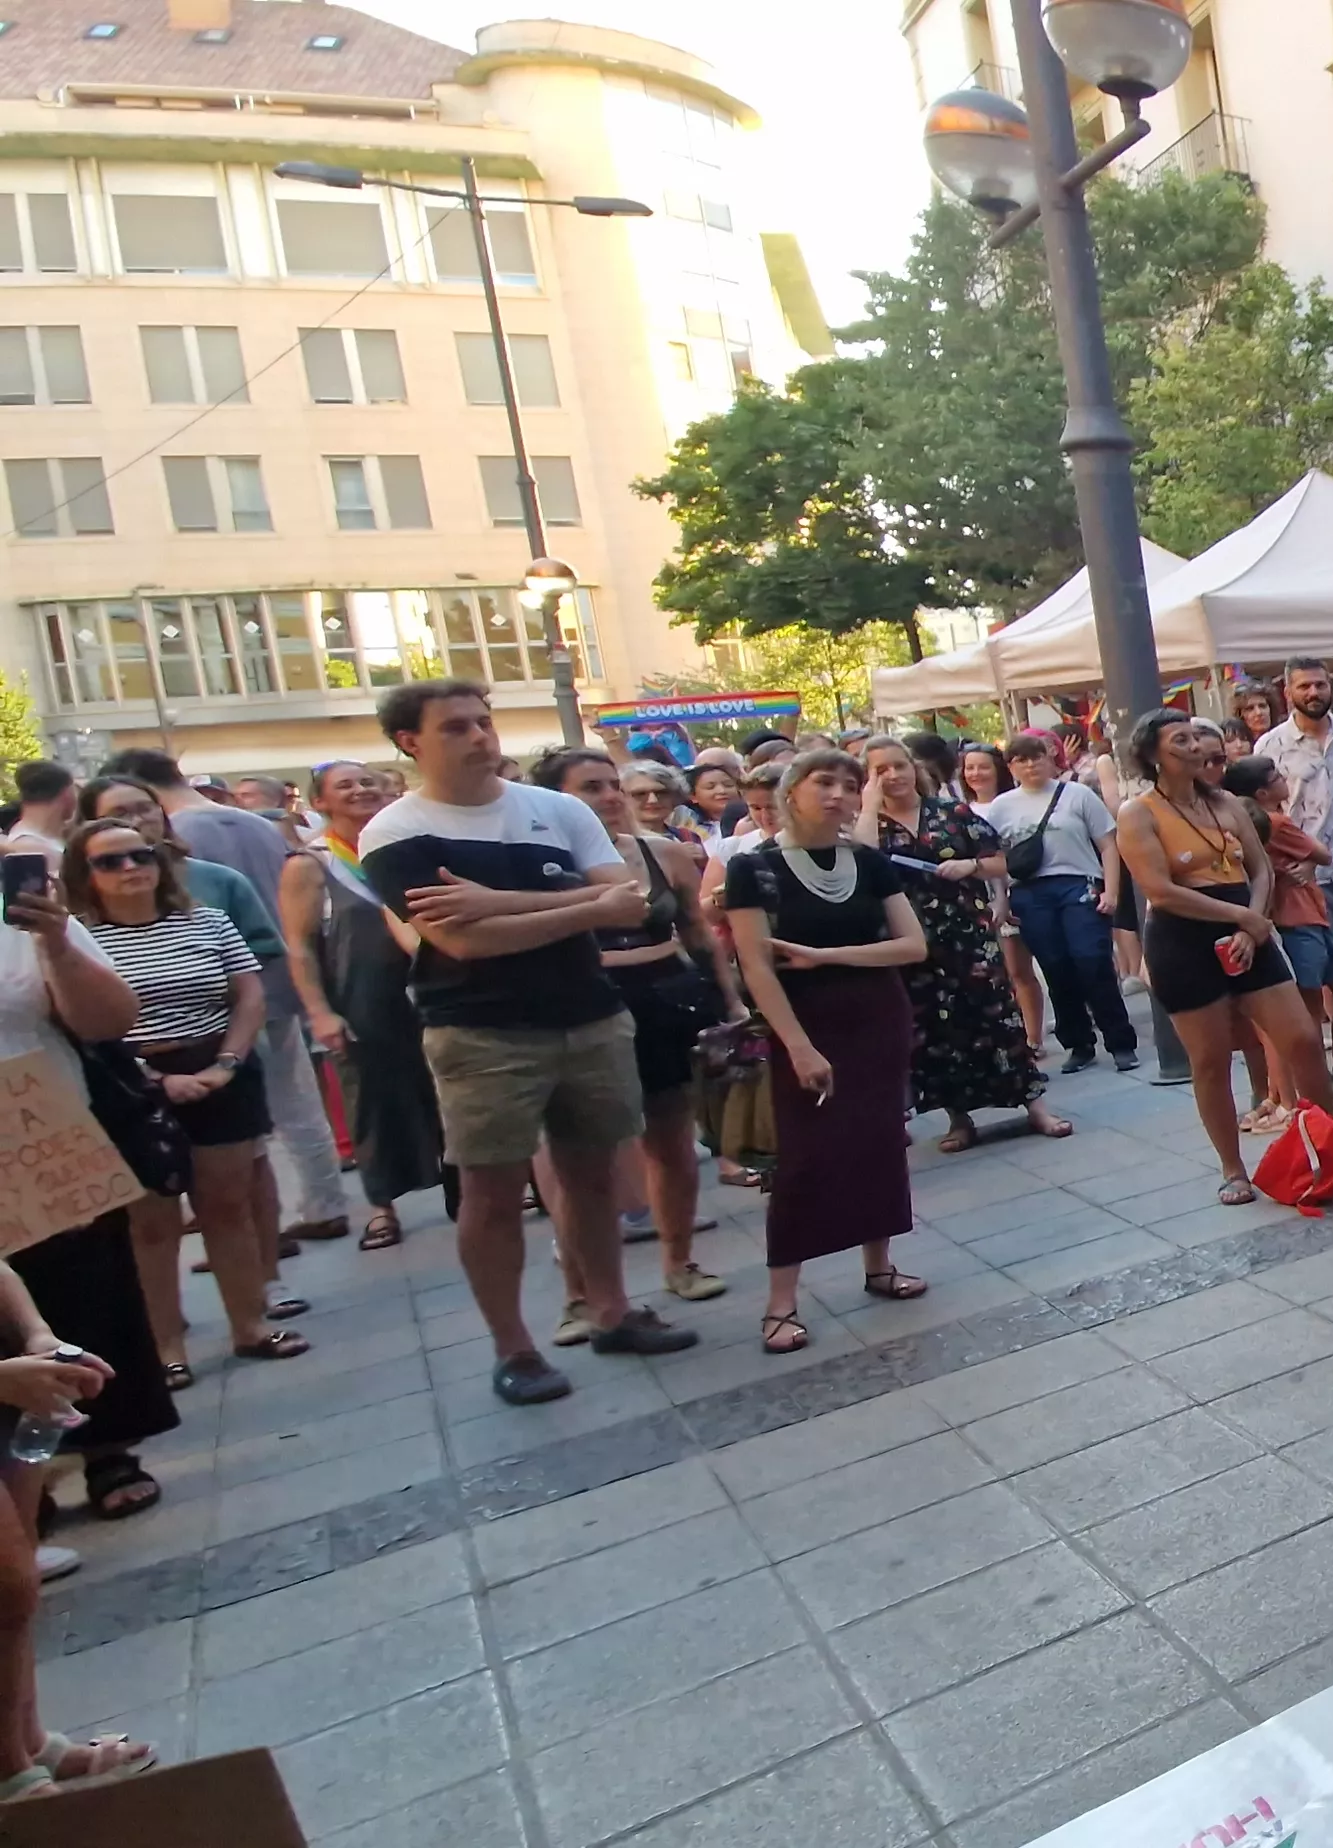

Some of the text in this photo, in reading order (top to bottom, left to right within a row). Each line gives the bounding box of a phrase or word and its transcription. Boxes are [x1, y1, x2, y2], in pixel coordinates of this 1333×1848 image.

[636, 699, 756, 718] LOVE IS LOVE
